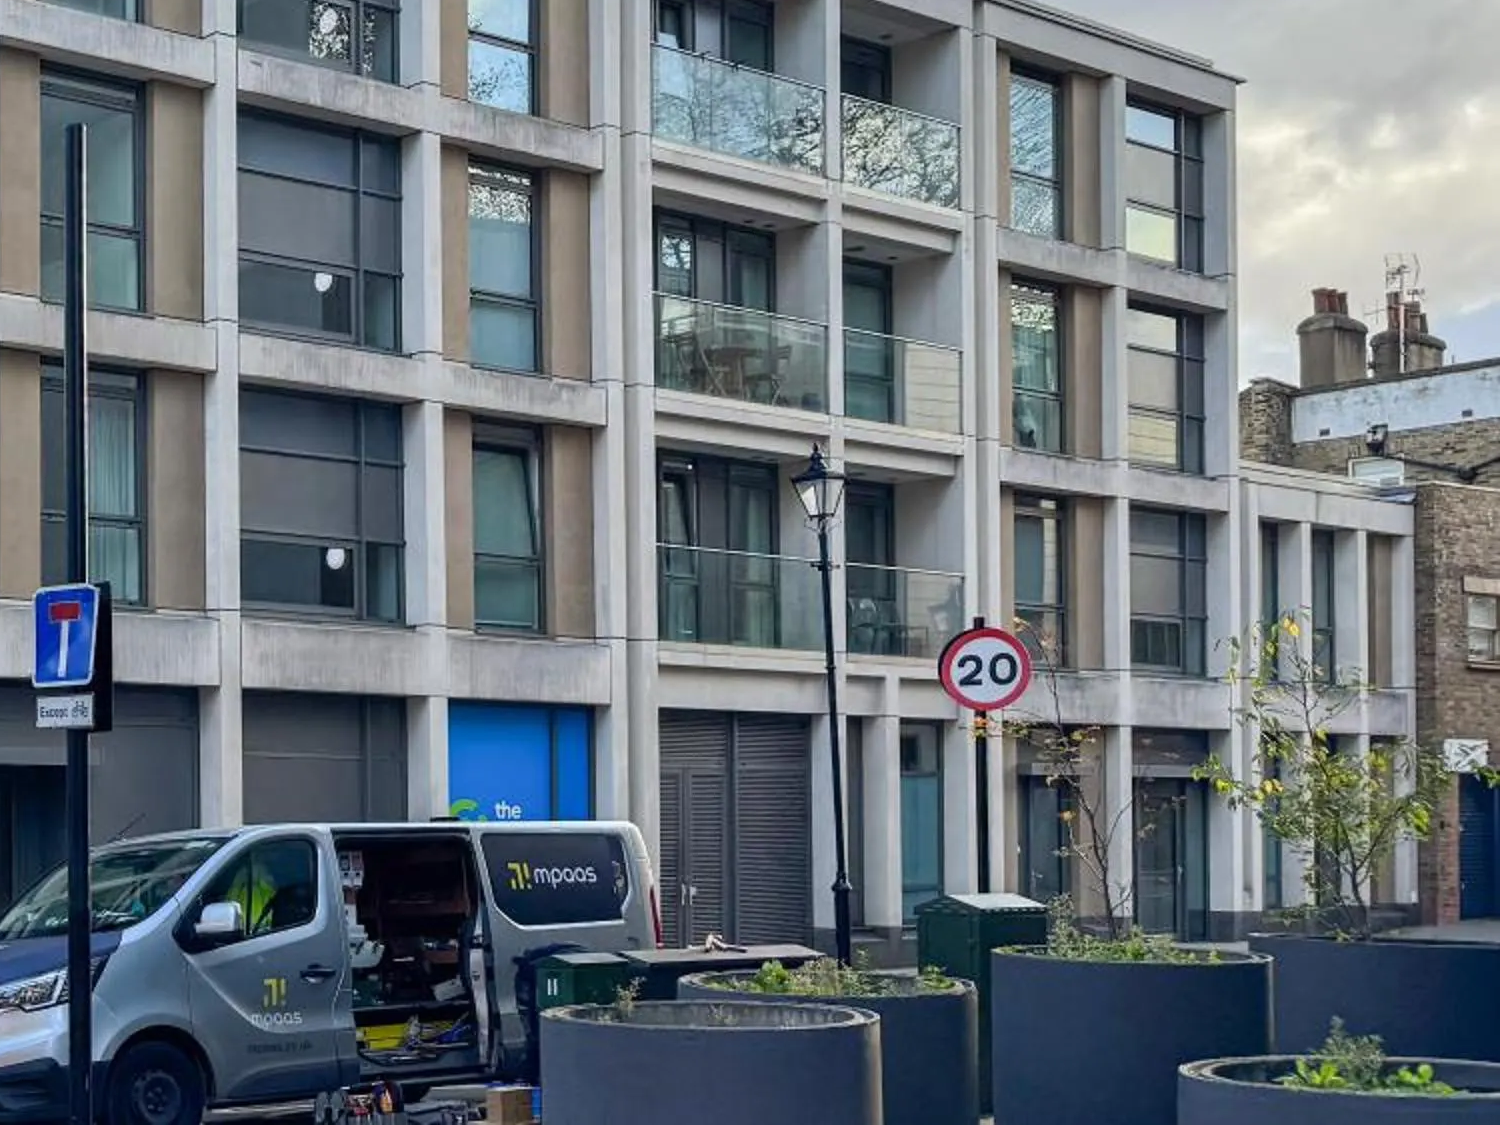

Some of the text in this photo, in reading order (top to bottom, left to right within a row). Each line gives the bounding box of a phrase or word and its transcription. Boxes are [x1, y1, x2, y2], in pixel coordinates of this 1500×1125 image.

[957, 652, 1018, 686] 20
[494, 800, 522, 819] the
[533, 866, 597, 889] mpaas
